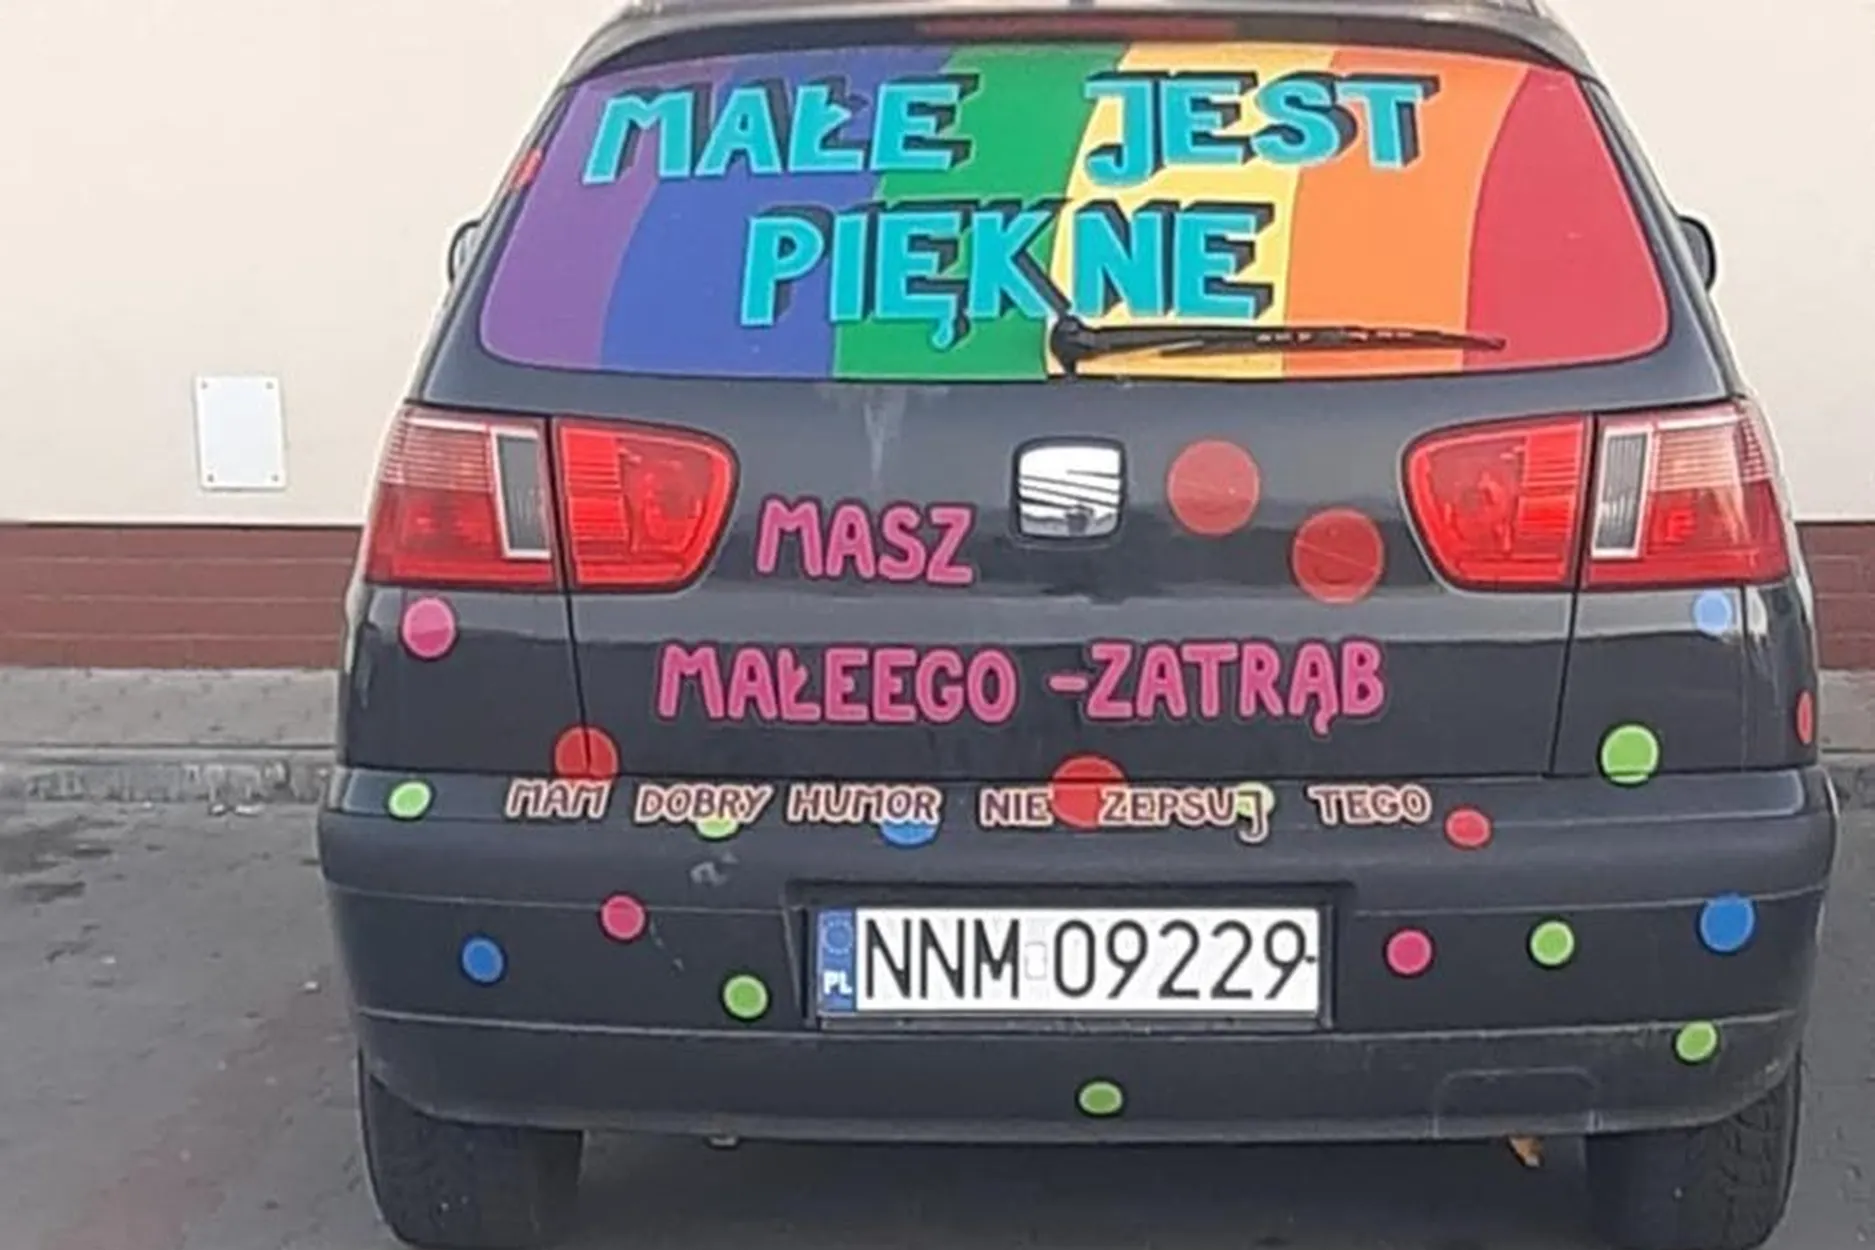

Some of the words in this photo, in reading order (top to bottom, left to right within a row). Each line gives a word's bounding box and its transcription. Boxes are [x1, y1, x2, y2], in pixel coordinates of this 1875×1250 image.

[582, 73, 979, 184] MAŁE
[1083, 70, 1440, 186] JEST
[740, 199, 1275, 350] PIĘKNE
[755, 495, 976, 586] MASZ
[656, 641, 1018, 725] MAŁEEGO
[505, 777, 612, 820] MAM
[634, 783, 774, 823] DOBRY
[787, 784, 942, 823] HUMOR
[978, 787, 1053, 829] NIE
[1098, 786, 1269, 845] ZEPSUJ
[1306, 784, 1432, 827] TEGO
[822, 972, 853, 995] PL
[865, 918, 1020, 1000] NNM
[1053, 919, 1308, 1000] 09229
